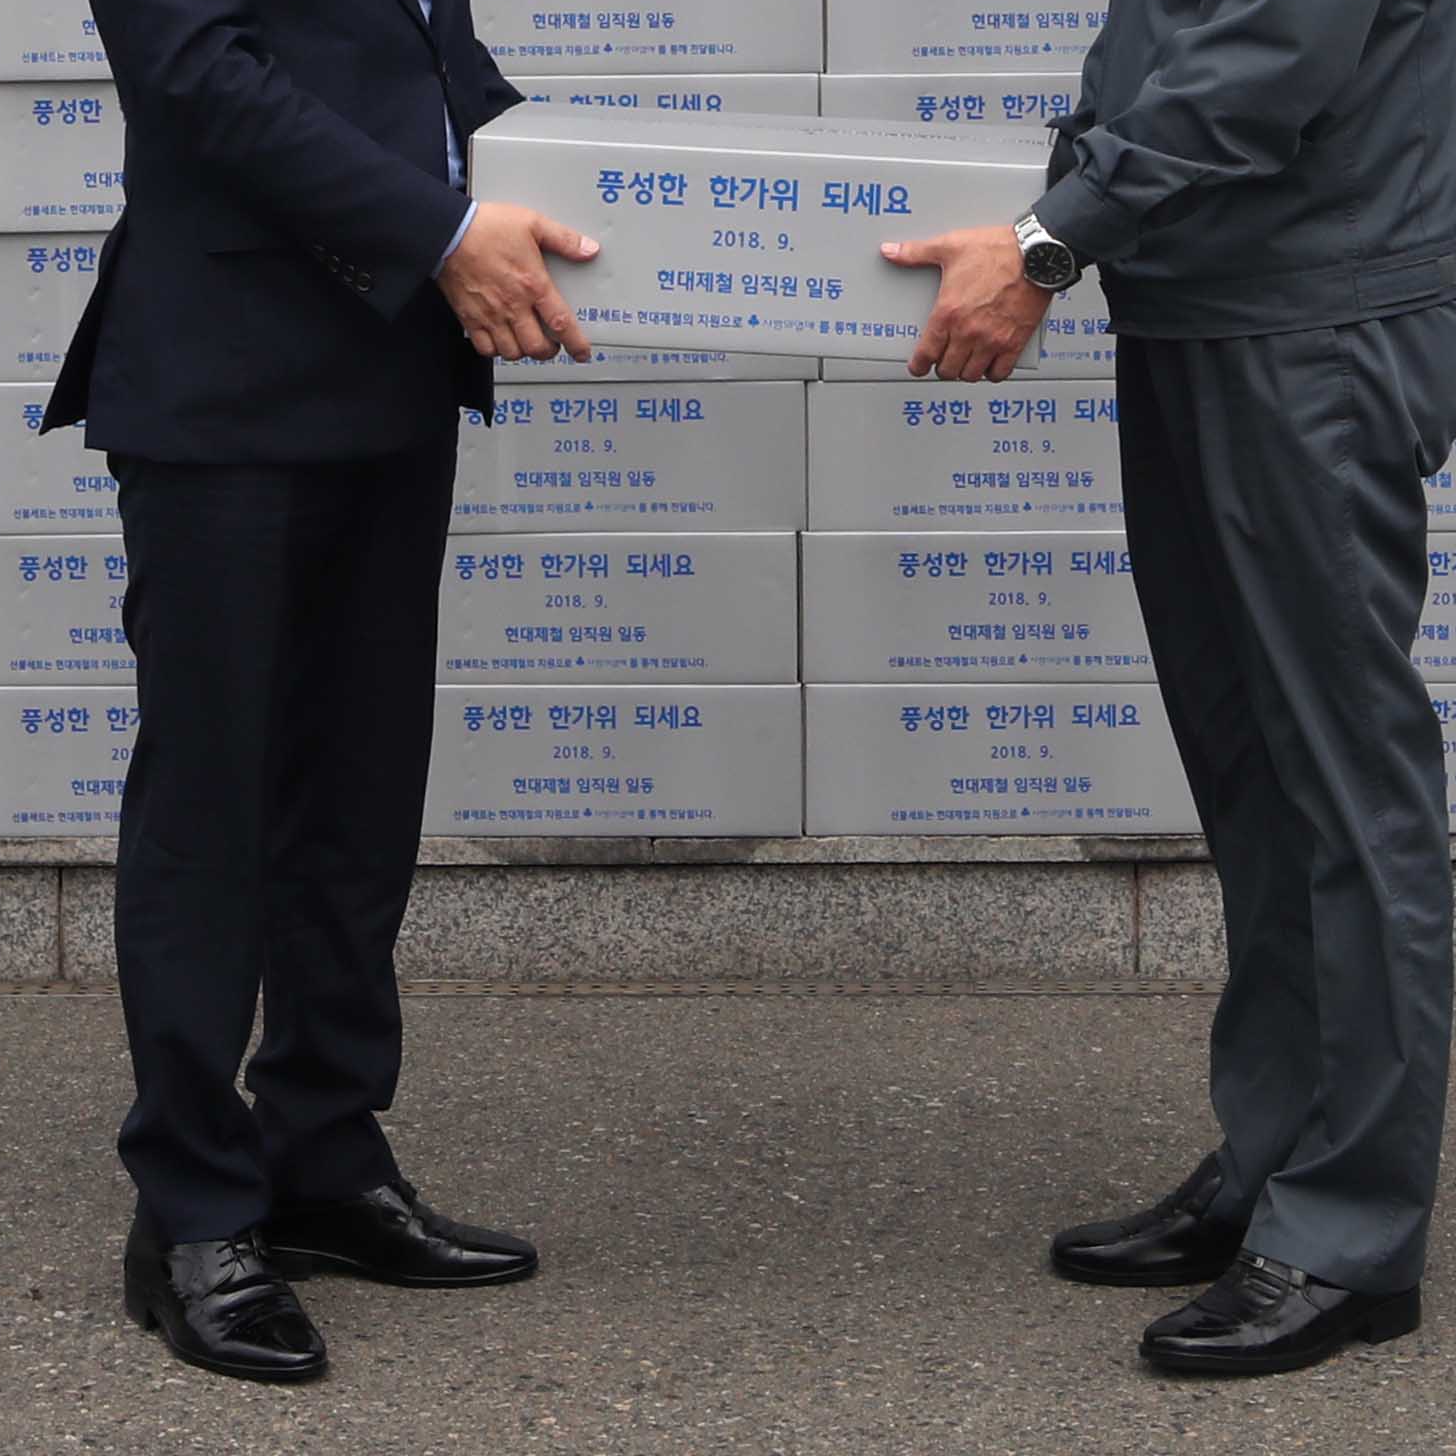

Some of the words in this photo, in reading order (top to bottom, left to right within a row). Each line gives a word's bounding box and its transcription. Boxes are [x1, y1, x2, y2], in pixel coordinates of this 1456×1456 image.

[596, 169, 689, 206] 풍성한
[709, 174, 800, 211] 한가위
[821, 181, 912, 216] 되세요
[712, 230, 766, 250] 2018.
[657, 269, 734, 294] 현대제철
[741, 275, 798, 297] 임직원
[805, 278, 844, 300] 일동
[576, 307, 633, 324] 선물세트는
[636, 311, 694, 327] 현대제철의
[697, 314, 743, 329] 지원으로
[835, 320, 858, 335] 통해
[463, 705, 532, 731] 풍성한
[548, 704, 617, 731] 한가위
[634, 703, 703, 729] 되세요
[513, 778, 571, 794] 현대제철
[577, 777, 620, 794] 임직원
[626, 777, 654, 794] 일동
